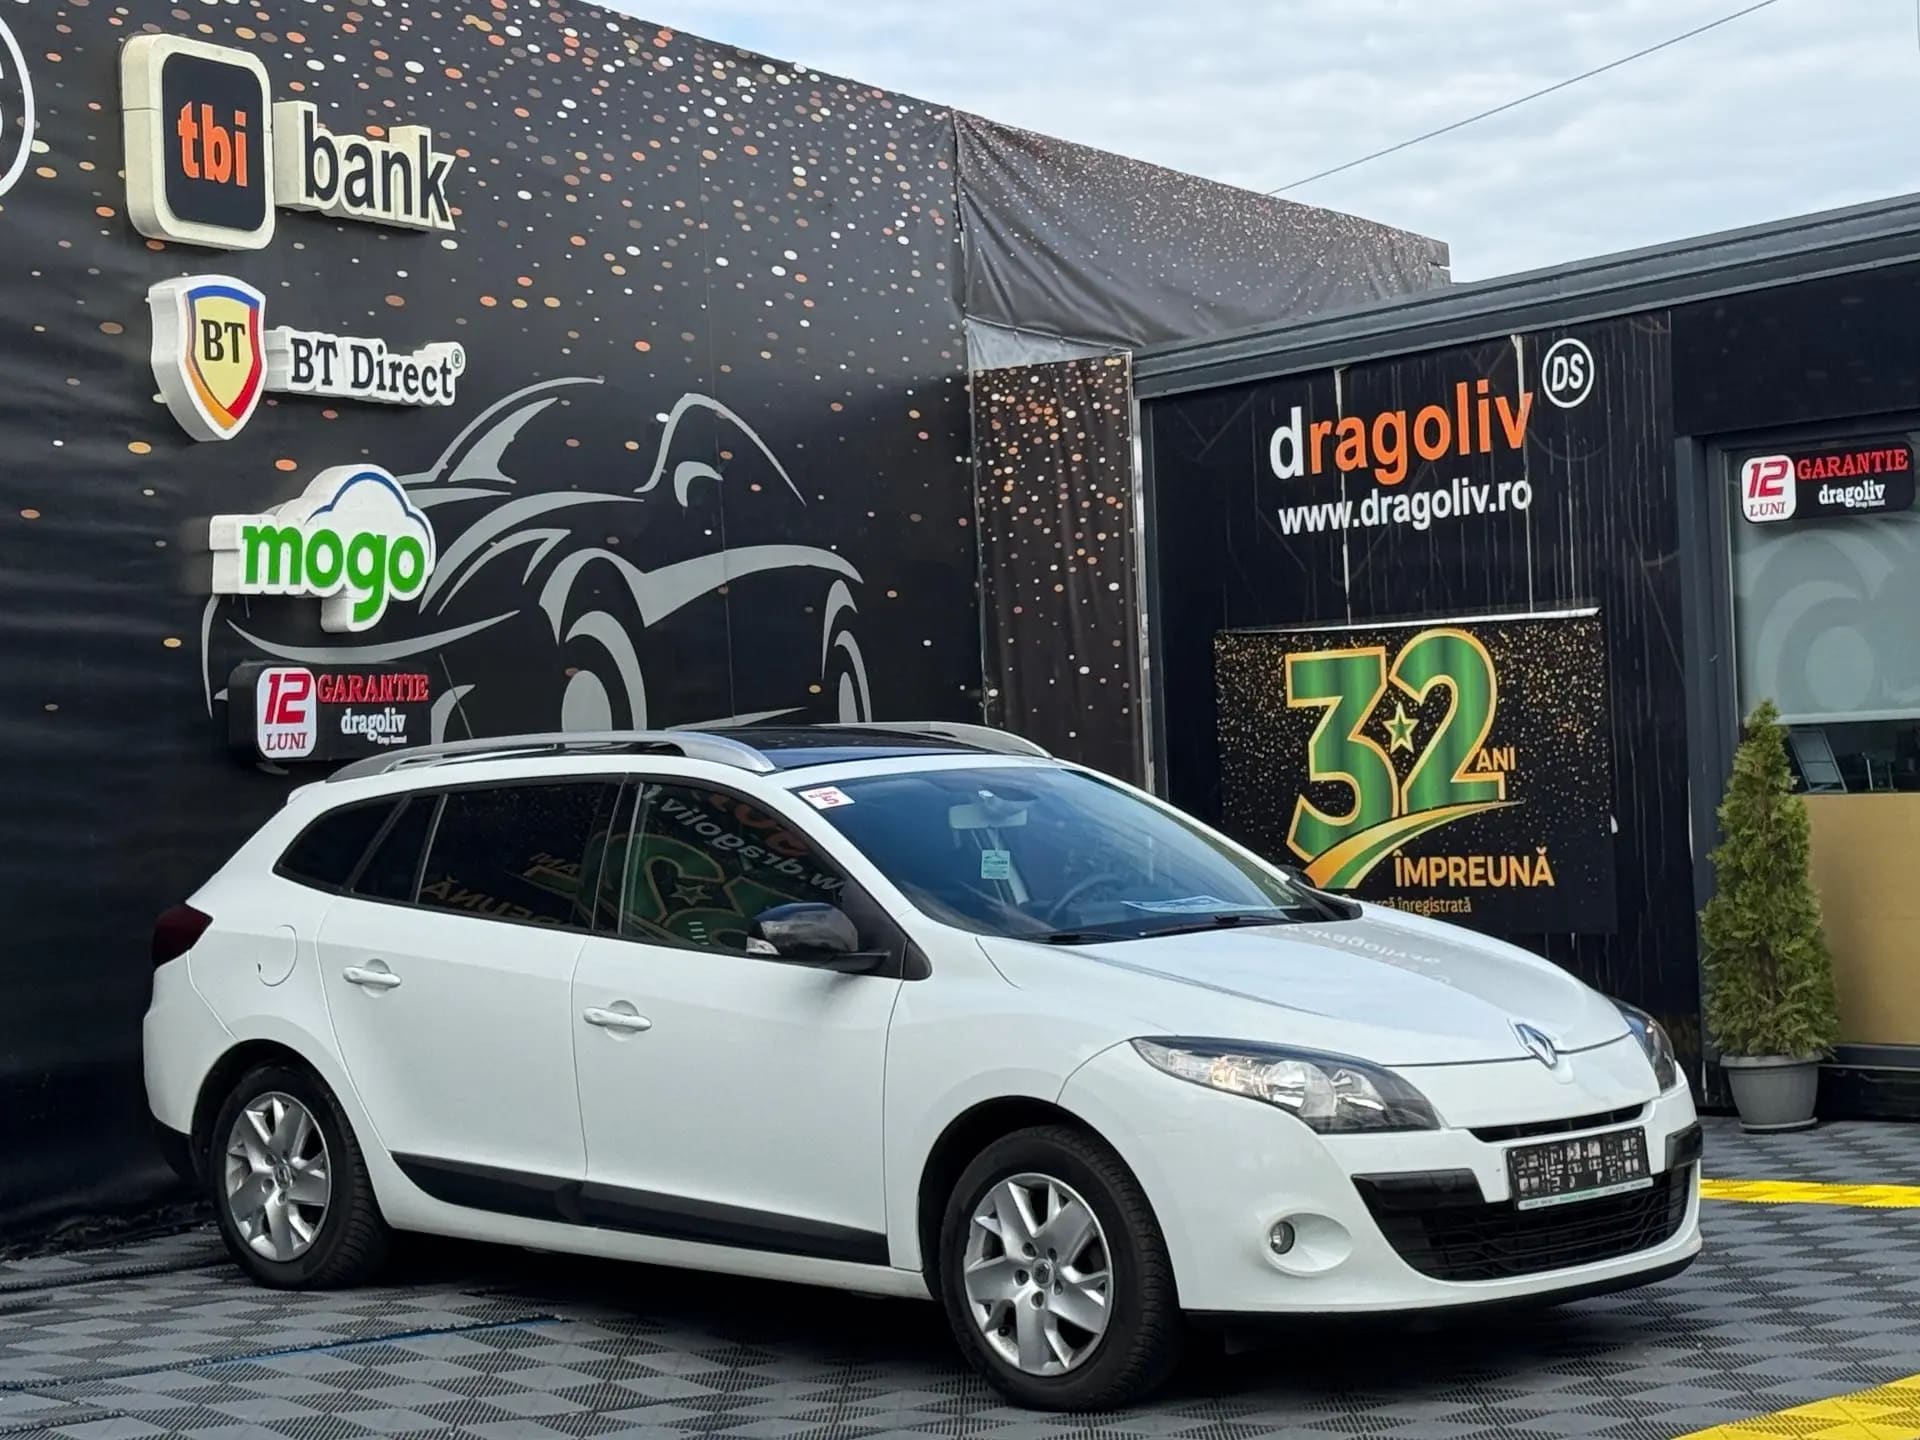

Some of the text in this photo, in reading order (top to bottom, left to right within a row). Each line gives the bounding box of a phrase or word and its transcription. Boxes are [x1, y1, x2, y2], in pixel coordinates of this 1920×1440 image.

[177, 101, 451, 226] tbi bank
[201, 318, 246, 364] BT
[290, 337, 338, 387] BT
[1551, 352, 1584, 393] DS
[1269, 378, 1533, 486] dragoliv
[1748, 460, 1788, 498] 12
[1797, 449, 1909, 480] GARANTIE
[1278, 476, 1533, 536] www.dragoliv.ro
[1750, 501, 1786, 517] LUNI
[1818, 479, 1885, 508] dragoliv
[242, 525, 425, 624] mogo
[264, 673, 311, 724] 12
[317, 673, 429, 703] GARANTIE
[266, 732, 308, 750] LUNI
[340, 707, 407, 741] dragoliv
[1285, 628, 1506, 864] 32
[1476, 747, 1516, 771] ANI
[1394, 847, 1555, 887] ÎMPREUNĂ
